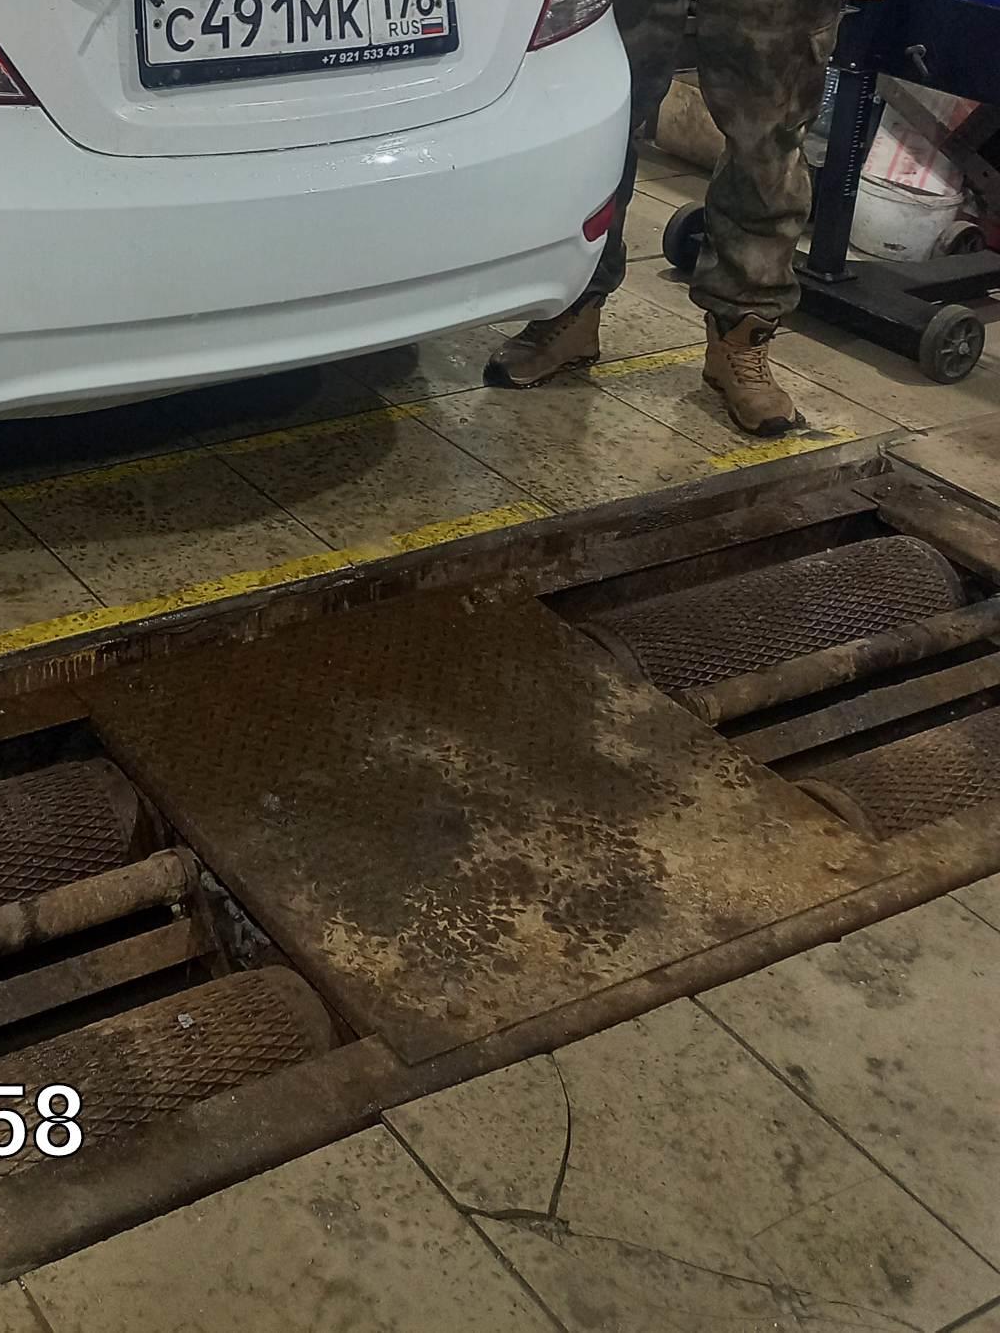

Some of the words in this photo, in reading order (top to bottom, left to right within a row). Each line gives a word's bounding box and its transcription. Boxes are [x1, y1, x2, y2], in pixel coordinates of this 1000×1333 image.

[388, 19, 421, 38] RUS
[321, 54, 337, 65] +7
[339, 50, 360, 64] 921
[362, 47, 384, 60] 533
[385, 45, 400, 58] 43
[401, 42, 415, 56] 21
